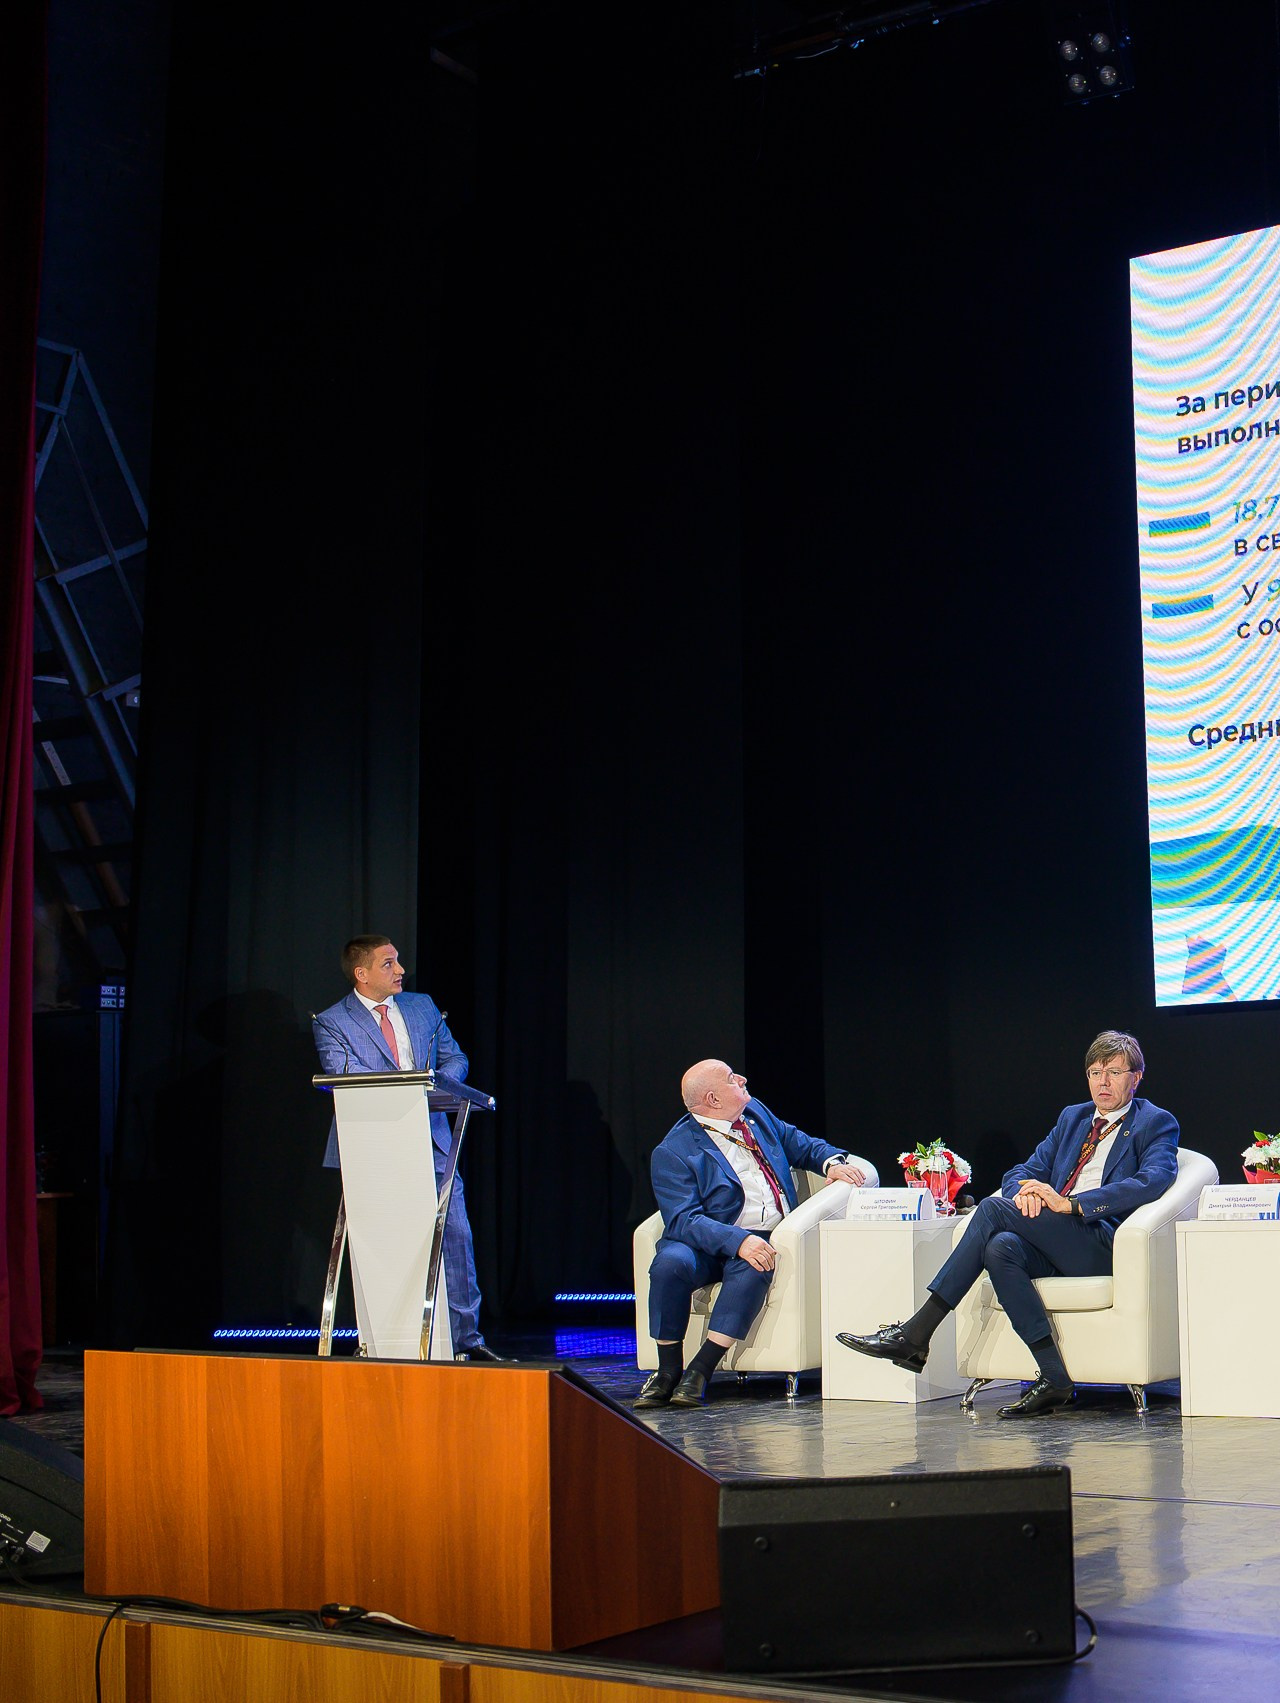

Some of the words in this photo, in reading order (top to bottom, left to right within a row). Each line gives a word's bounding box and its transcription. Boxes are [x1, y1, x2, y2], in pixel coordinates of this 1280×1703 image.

[1176, 395, 1206, 417] За
[1234, 538, 1248, 556] в
[1242, 582, 1259, 606] У
[1237, 621, 1250, 639] с
